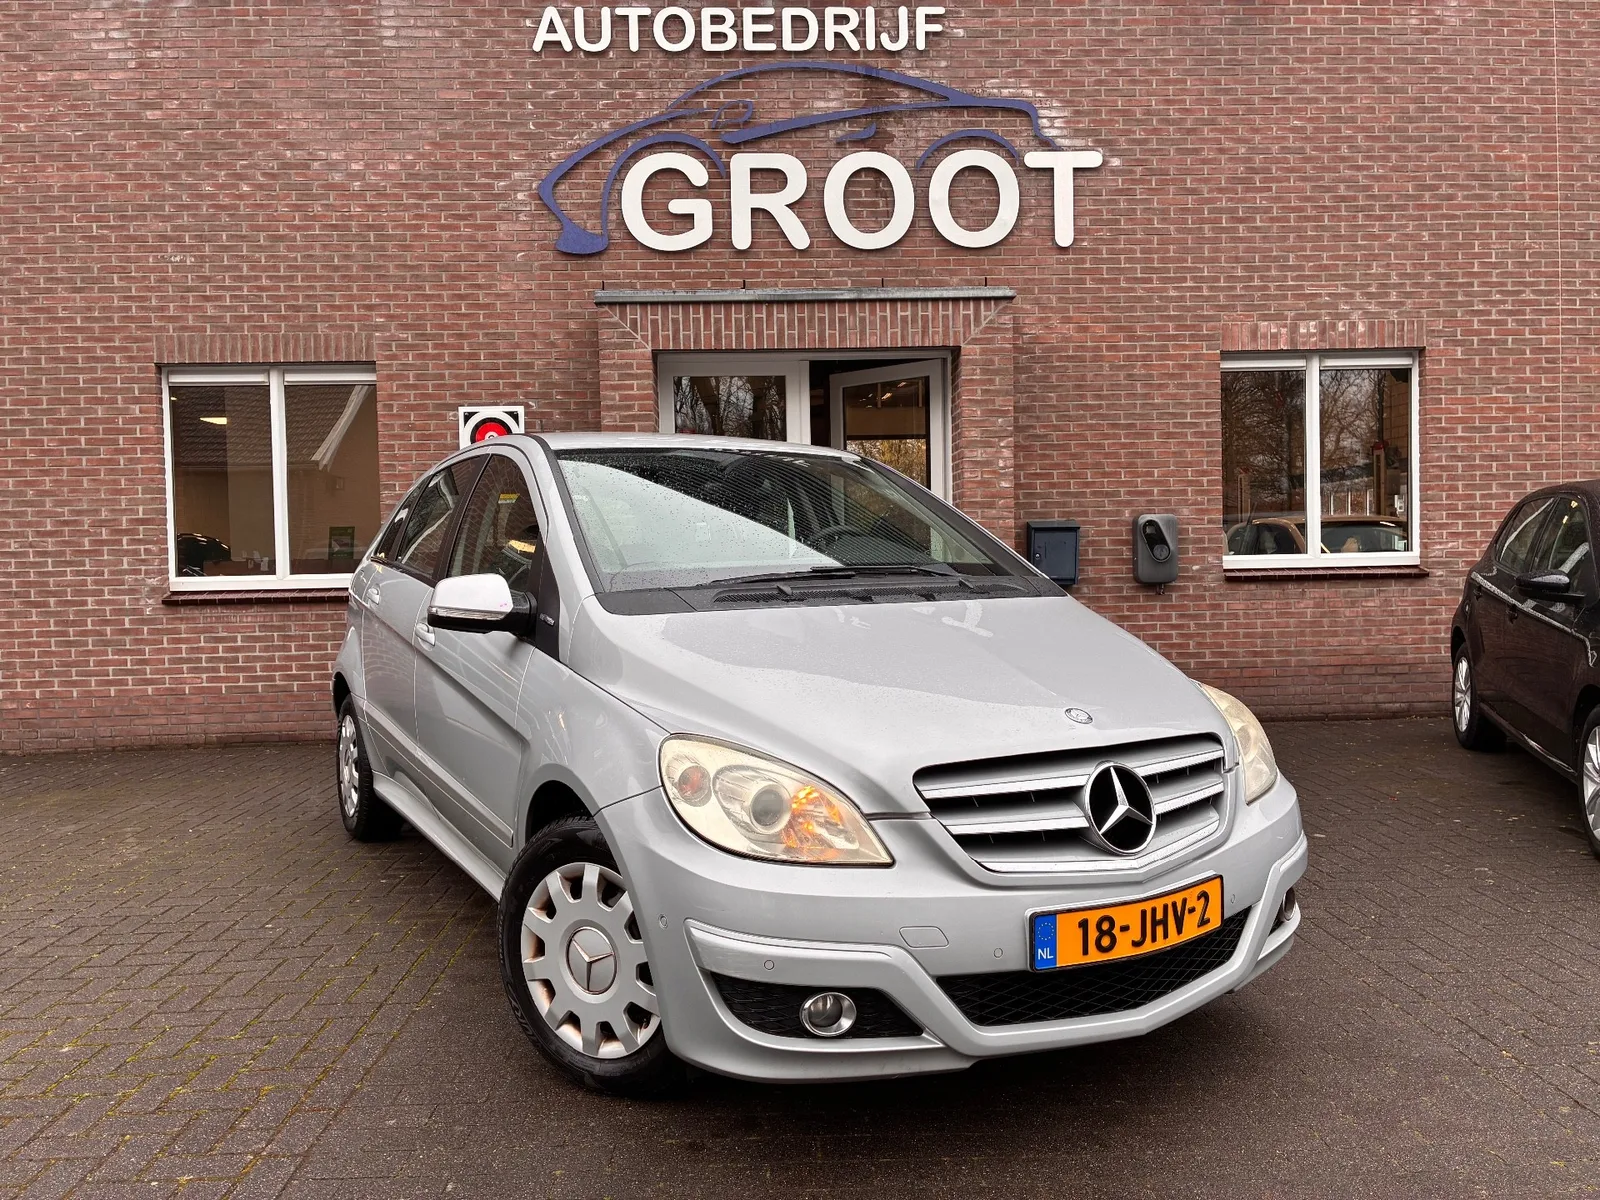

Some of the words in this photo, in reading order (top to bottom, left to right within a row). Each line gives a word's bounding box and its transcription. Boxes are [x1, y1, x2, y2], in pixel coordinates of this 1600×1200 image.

[532, 7, 946, 52] AUTOBEDRIJF
[621, 150, 1103, 251] GROOT
[1078, 890, 1210, 956] 18-JHV-2
[1037, 947, 1054, 960] NL
